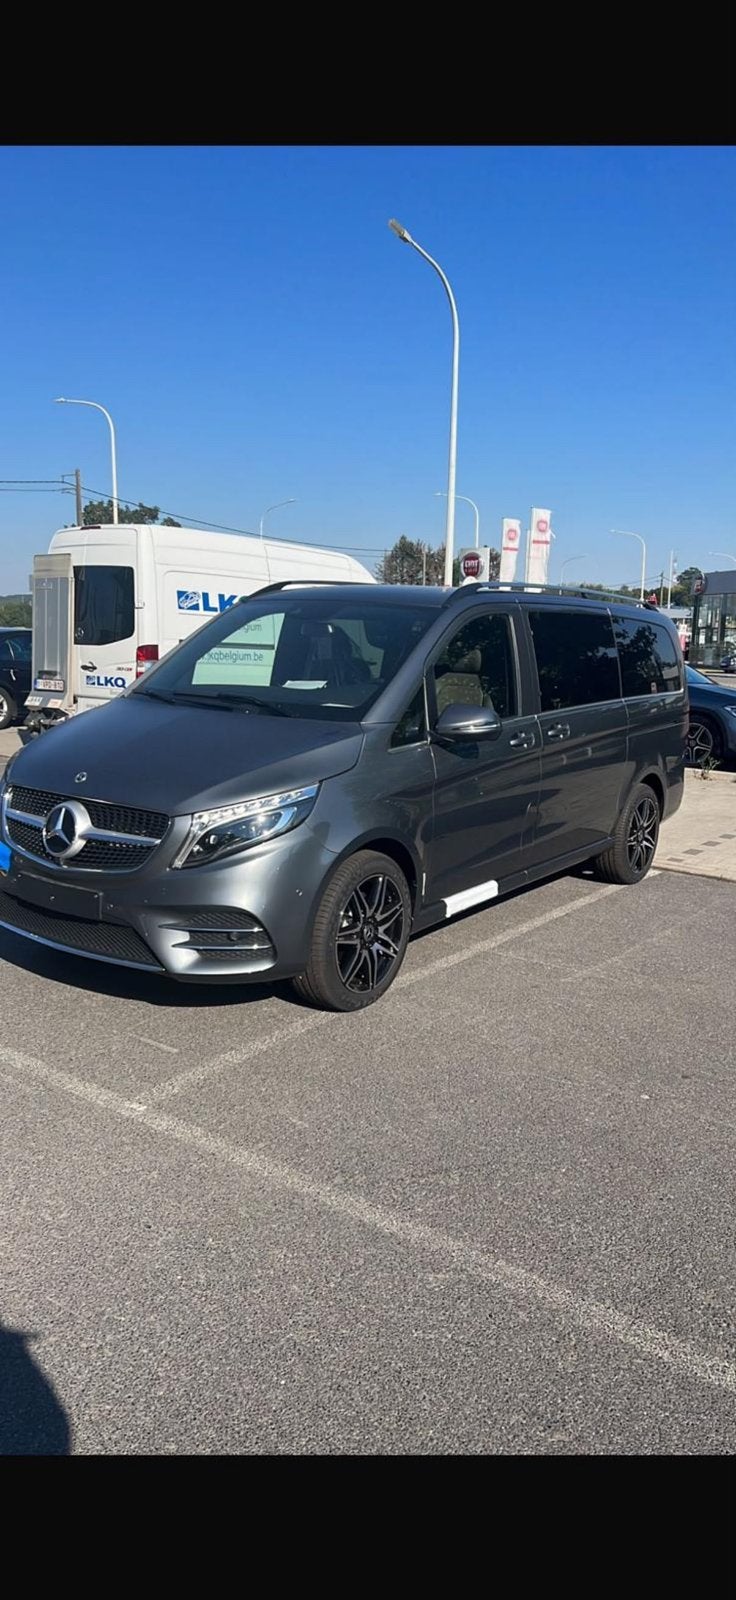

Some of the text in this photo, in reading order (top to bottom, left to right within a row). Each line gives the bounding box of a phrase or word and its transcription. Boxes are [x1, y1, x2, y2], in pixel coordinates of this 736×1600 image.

[202, 592, 243, 613] LK
[243, 623, 263, 633] gium
[97, 676, 126, 689] LKQ
